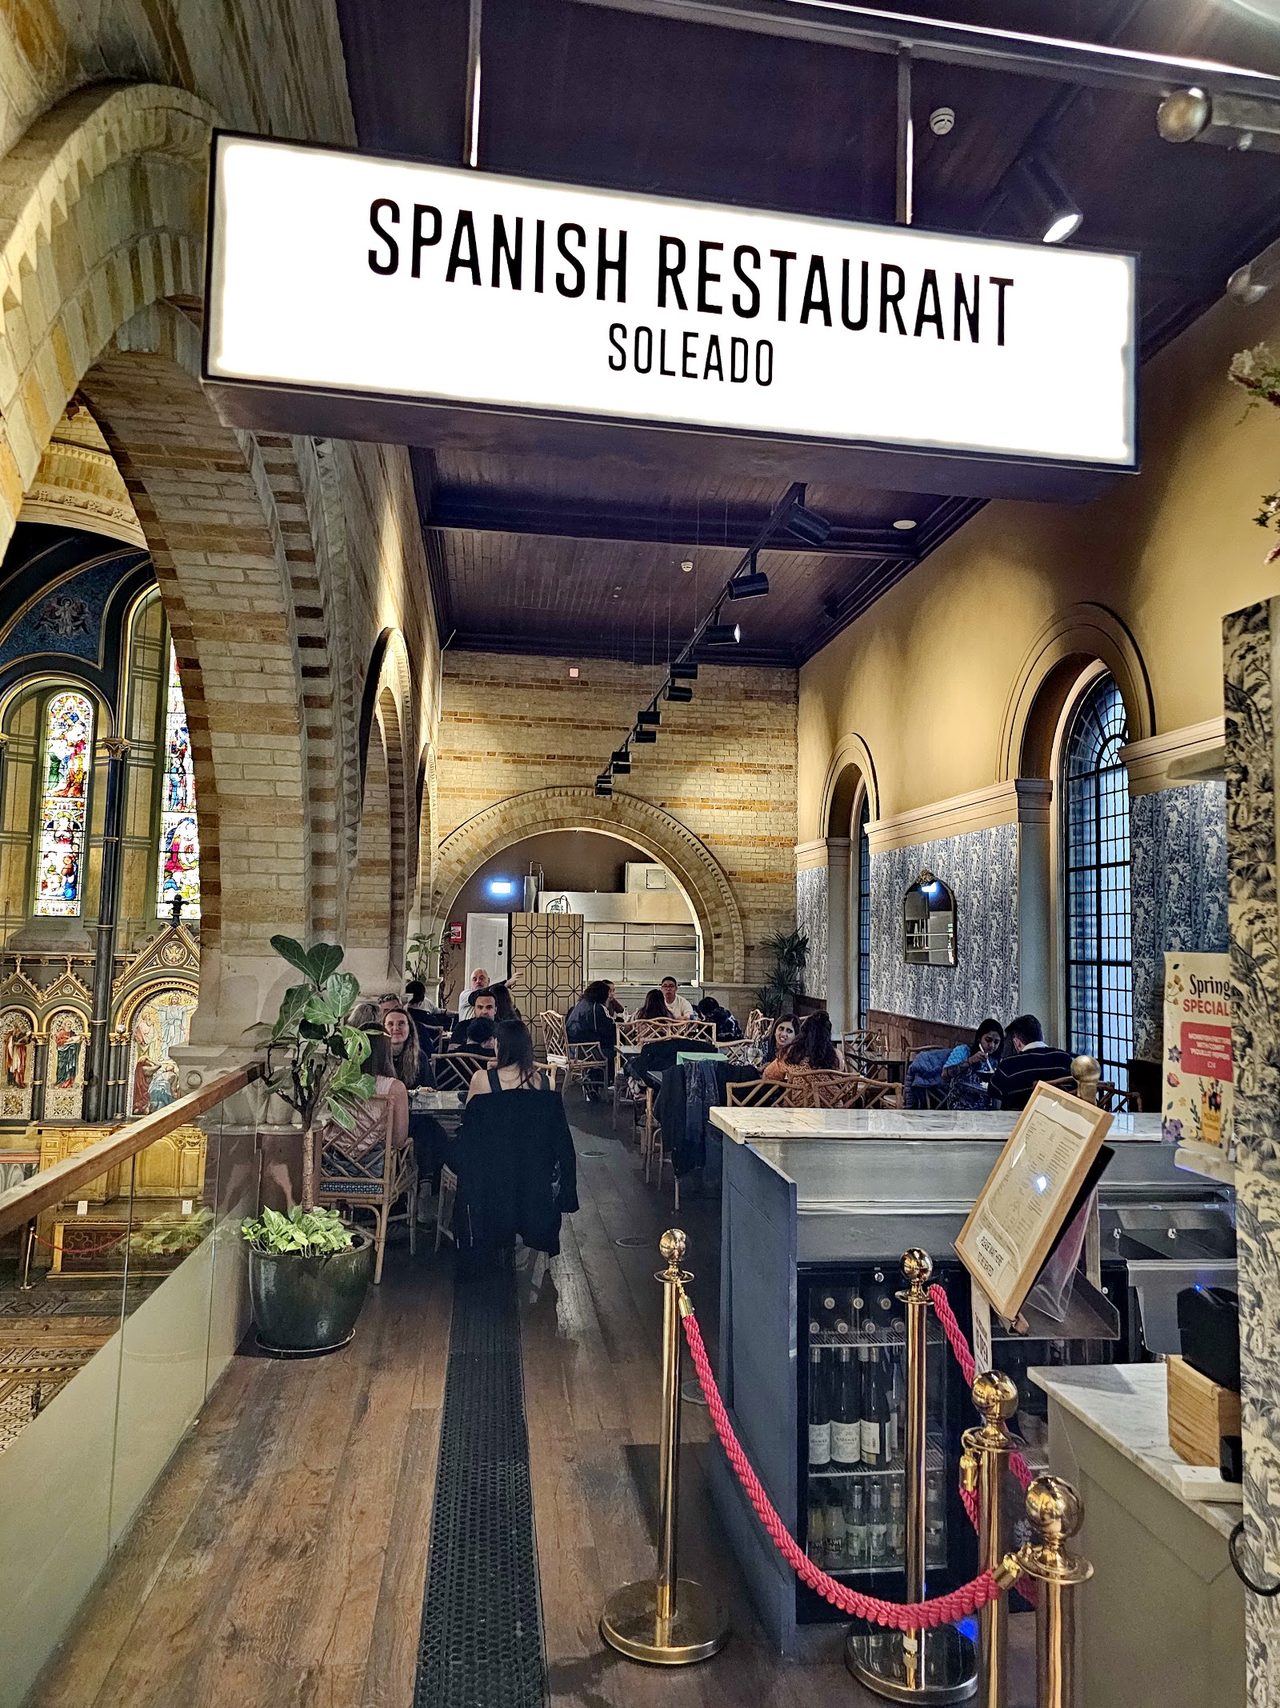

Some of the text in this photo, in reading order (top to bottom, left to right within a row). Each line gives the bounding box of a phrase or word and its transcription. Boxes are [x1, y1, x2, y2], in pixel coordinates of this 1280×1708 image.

[368, 198, 1014, 347] SPANISH RESTAURANT
[608, 322, 774, 387] SOLEADO
[1189, 974, 1231, 1001] Spring
